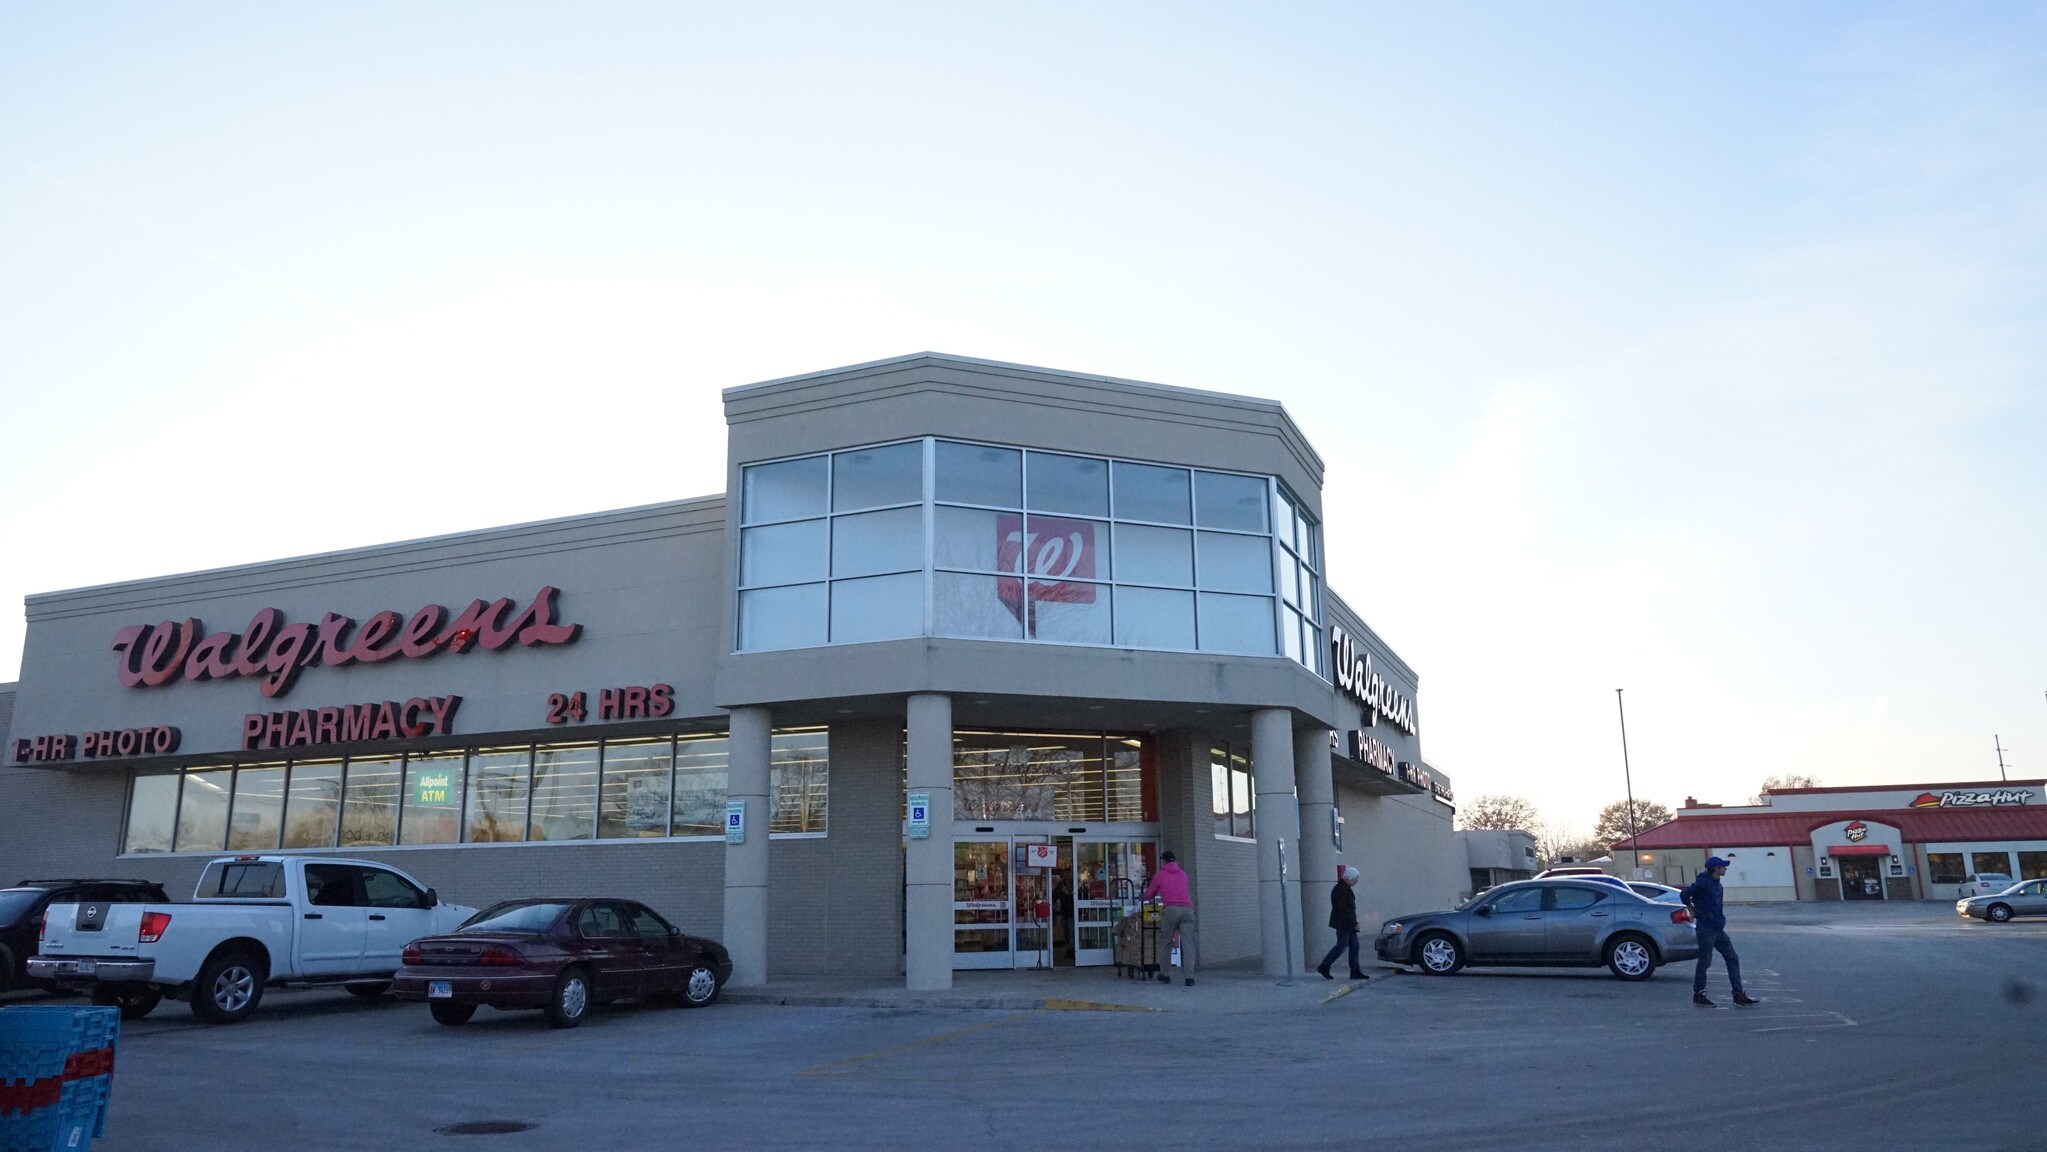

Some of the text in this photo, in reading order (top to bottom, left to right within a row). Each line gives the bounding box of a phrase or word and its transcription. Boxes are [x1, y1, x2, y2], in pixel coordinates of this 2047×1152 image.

[112, 586, 582, 698] Walgreens
[1332, 625, 1416, 736] Walgreens
[547, 683, 674, 723] 24 HRS
[242, 695, 462, 749] PHARMACY
[80, 725, 180, 758] PHOTO
[1356, 730, 1395, 775] PHARMACY
[420, 776, 449, 789] Allpoint
[421, 790, 445, 802] ATM
[1847, 827, 1867, 837] Pizza
[1851, 832, 1865, 840] Hut
